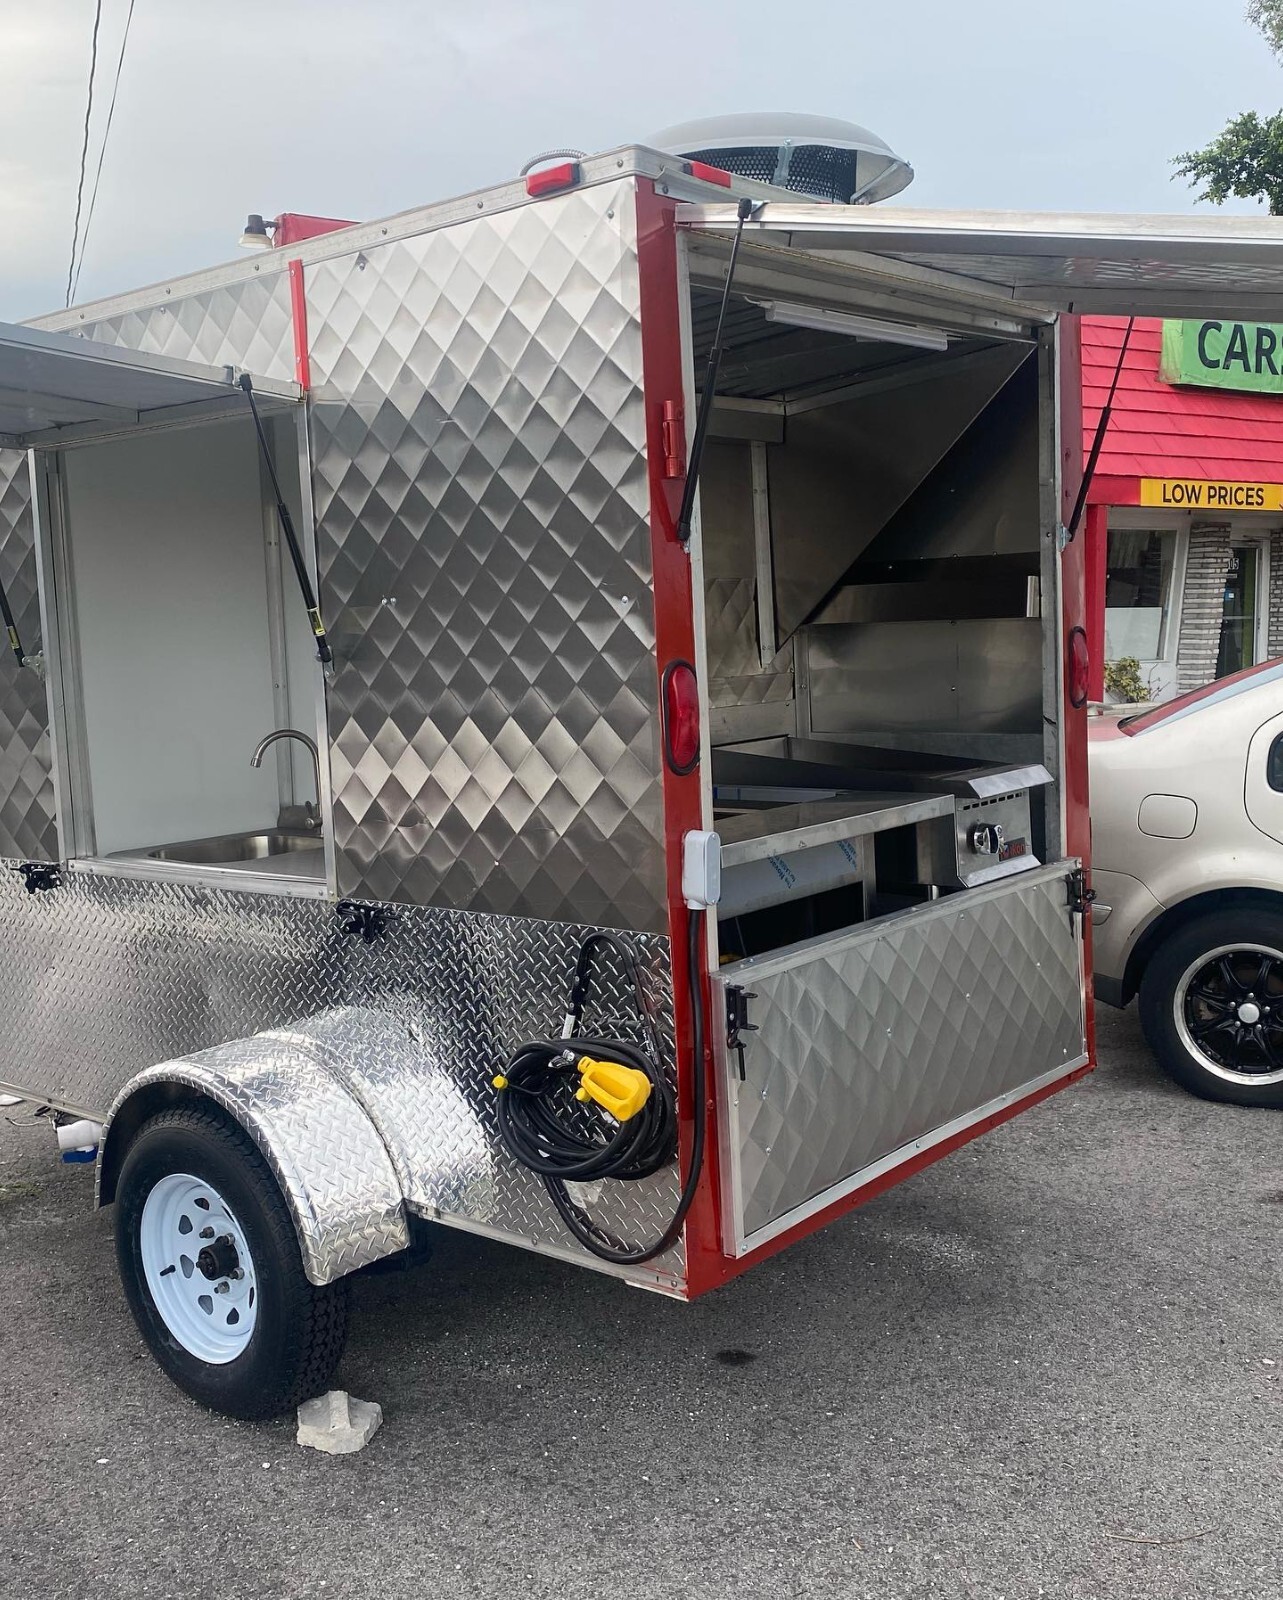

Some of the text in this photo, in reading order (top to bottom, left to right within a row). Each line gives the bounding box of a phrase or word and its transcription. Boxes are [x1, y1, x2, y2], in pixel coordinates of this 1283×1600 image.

[1198, 321, 1283, 376] CAR
[1162, 483, 1264, 506] LOW PRICES
